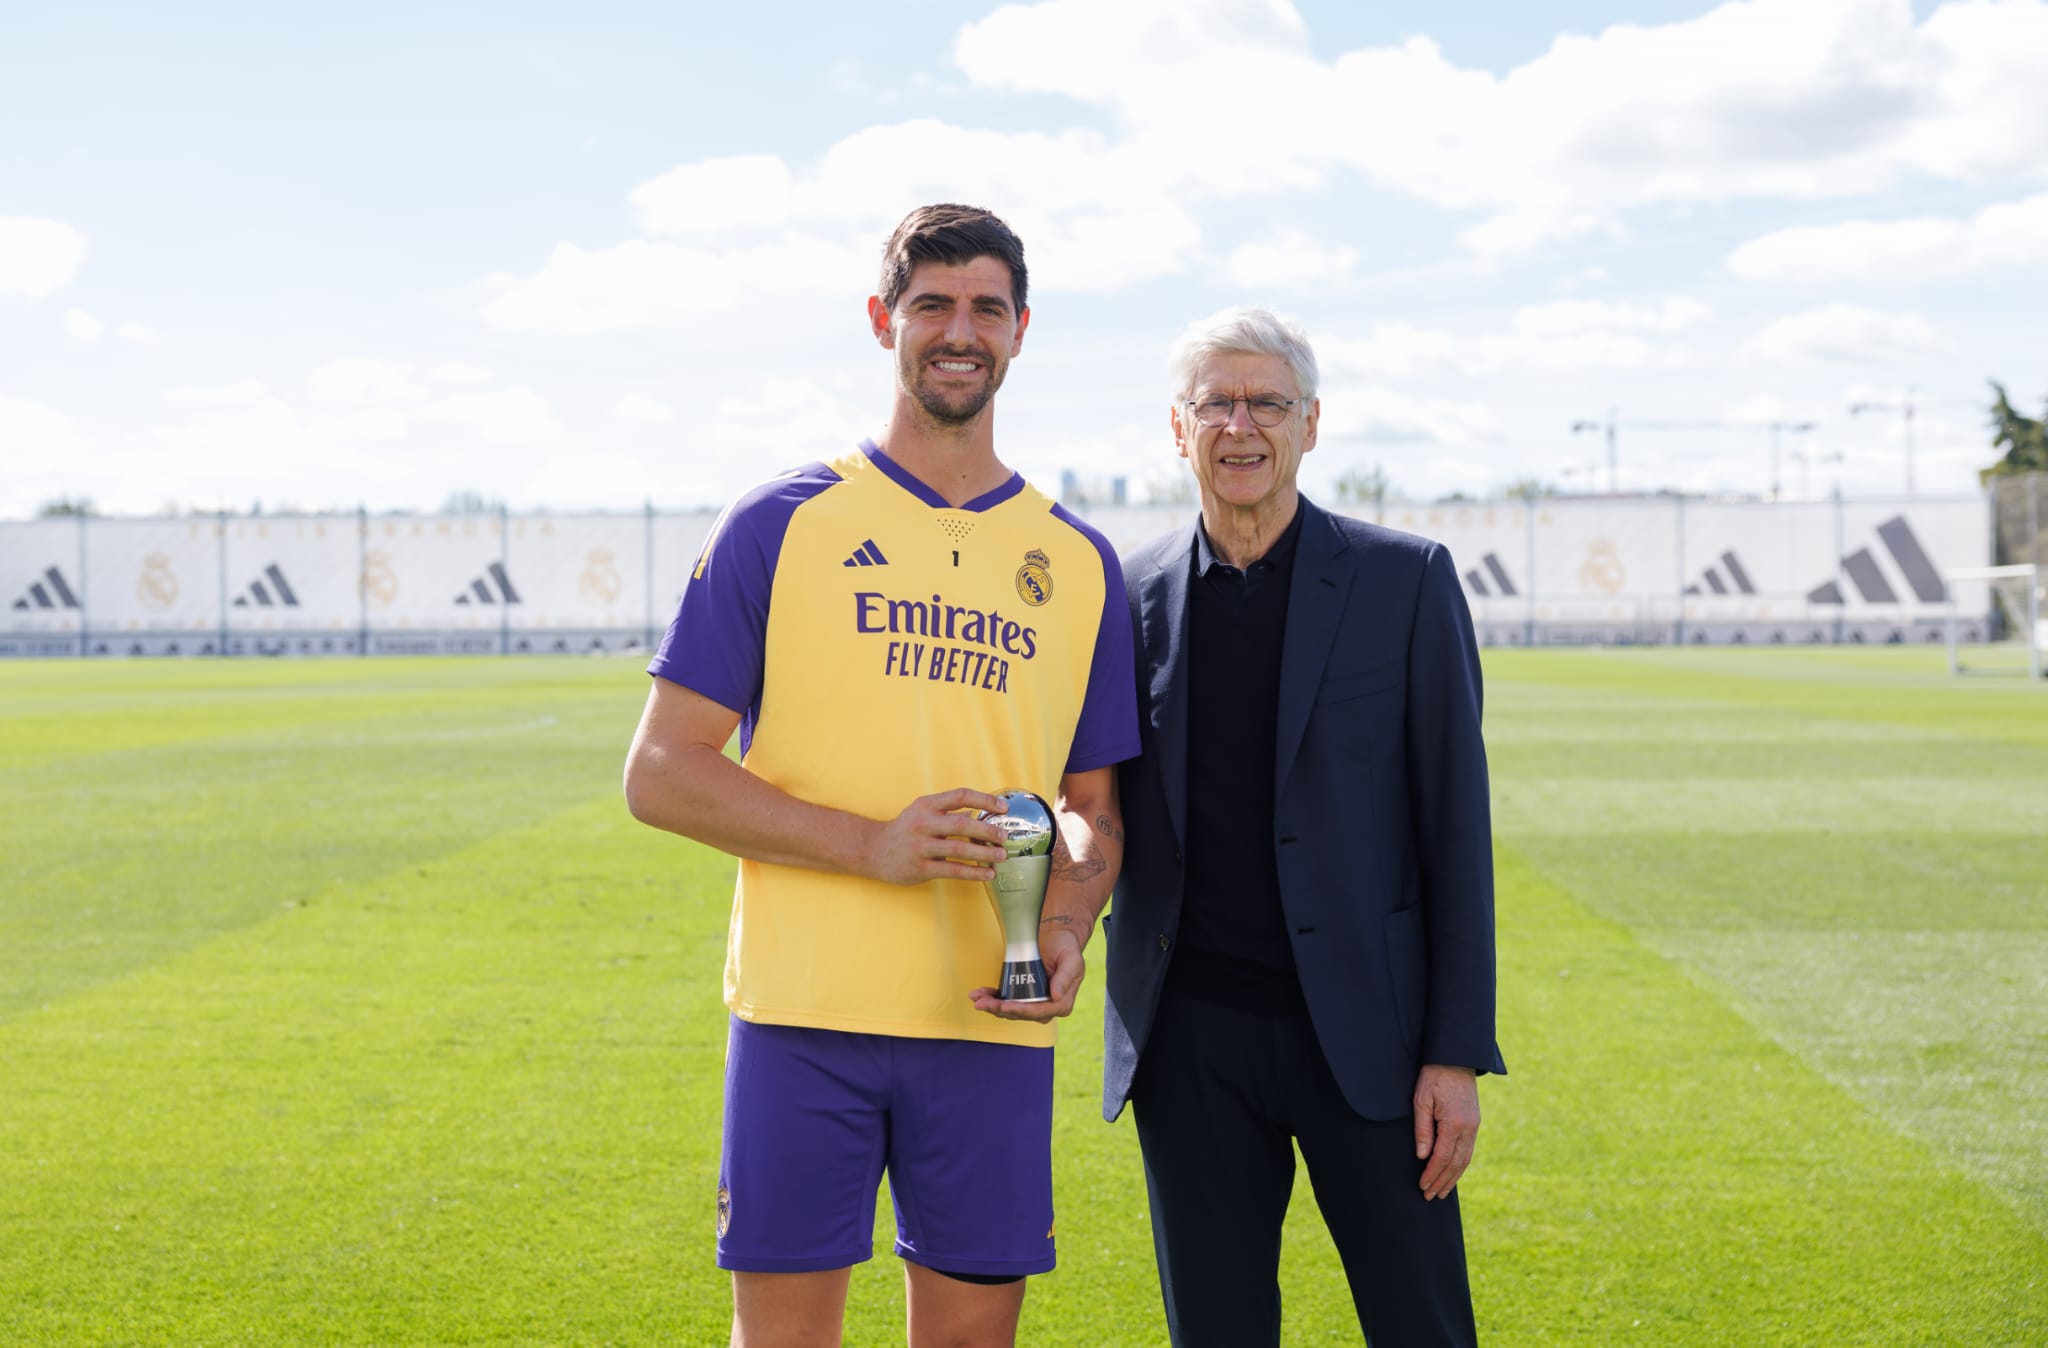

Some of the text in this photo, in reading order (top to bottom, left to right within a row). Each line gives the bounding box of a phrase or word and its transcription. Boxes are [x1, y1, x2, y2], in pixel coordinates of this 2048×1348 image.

[952, 550, 960, 567] 1
[854, 592, 1037, 660] Emirates
[885, 642, 1009, 694] FLY BETTER
[1009, 973, 1036, 985] FIFA
